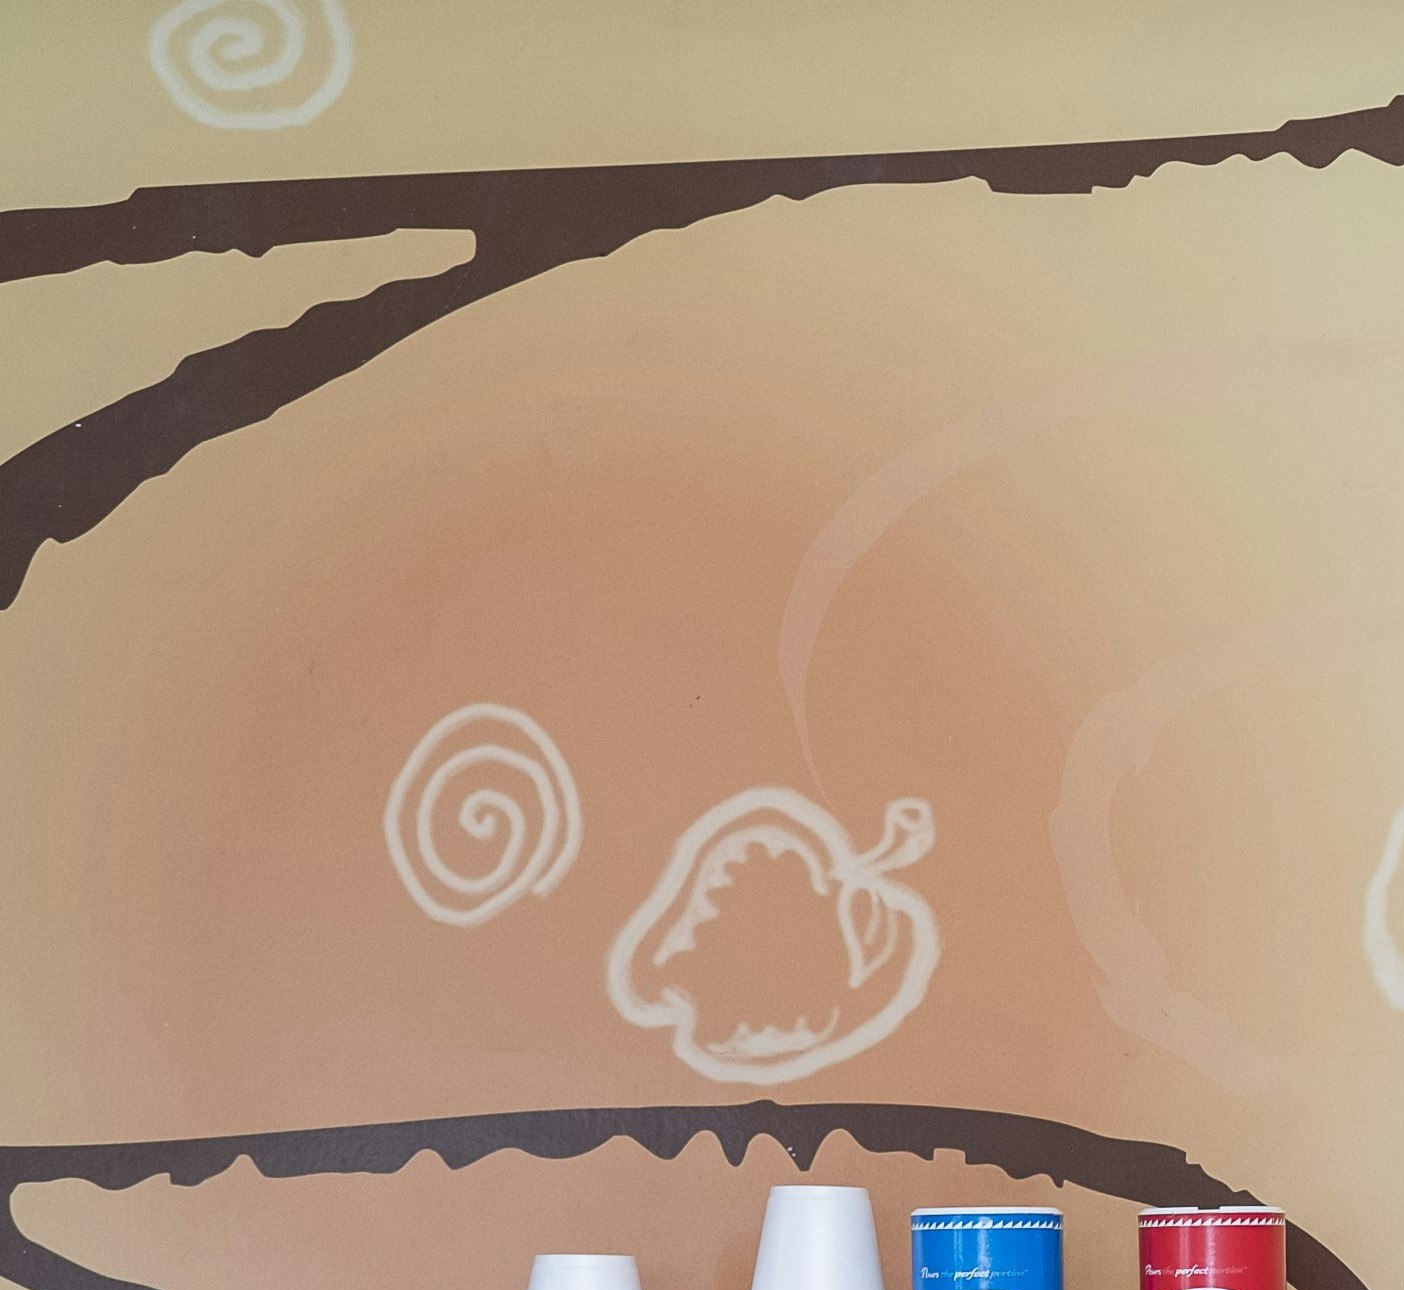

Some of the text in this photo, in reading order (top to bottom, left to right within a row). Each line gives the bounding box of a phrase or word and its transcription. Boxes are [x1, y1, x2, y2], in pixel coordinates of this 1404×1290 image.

[953, 1266, 990, 1281] perfect
[1174, 1264, 1209, 1278] perfect
[1208, 1266, 1244, 1276] ortion
